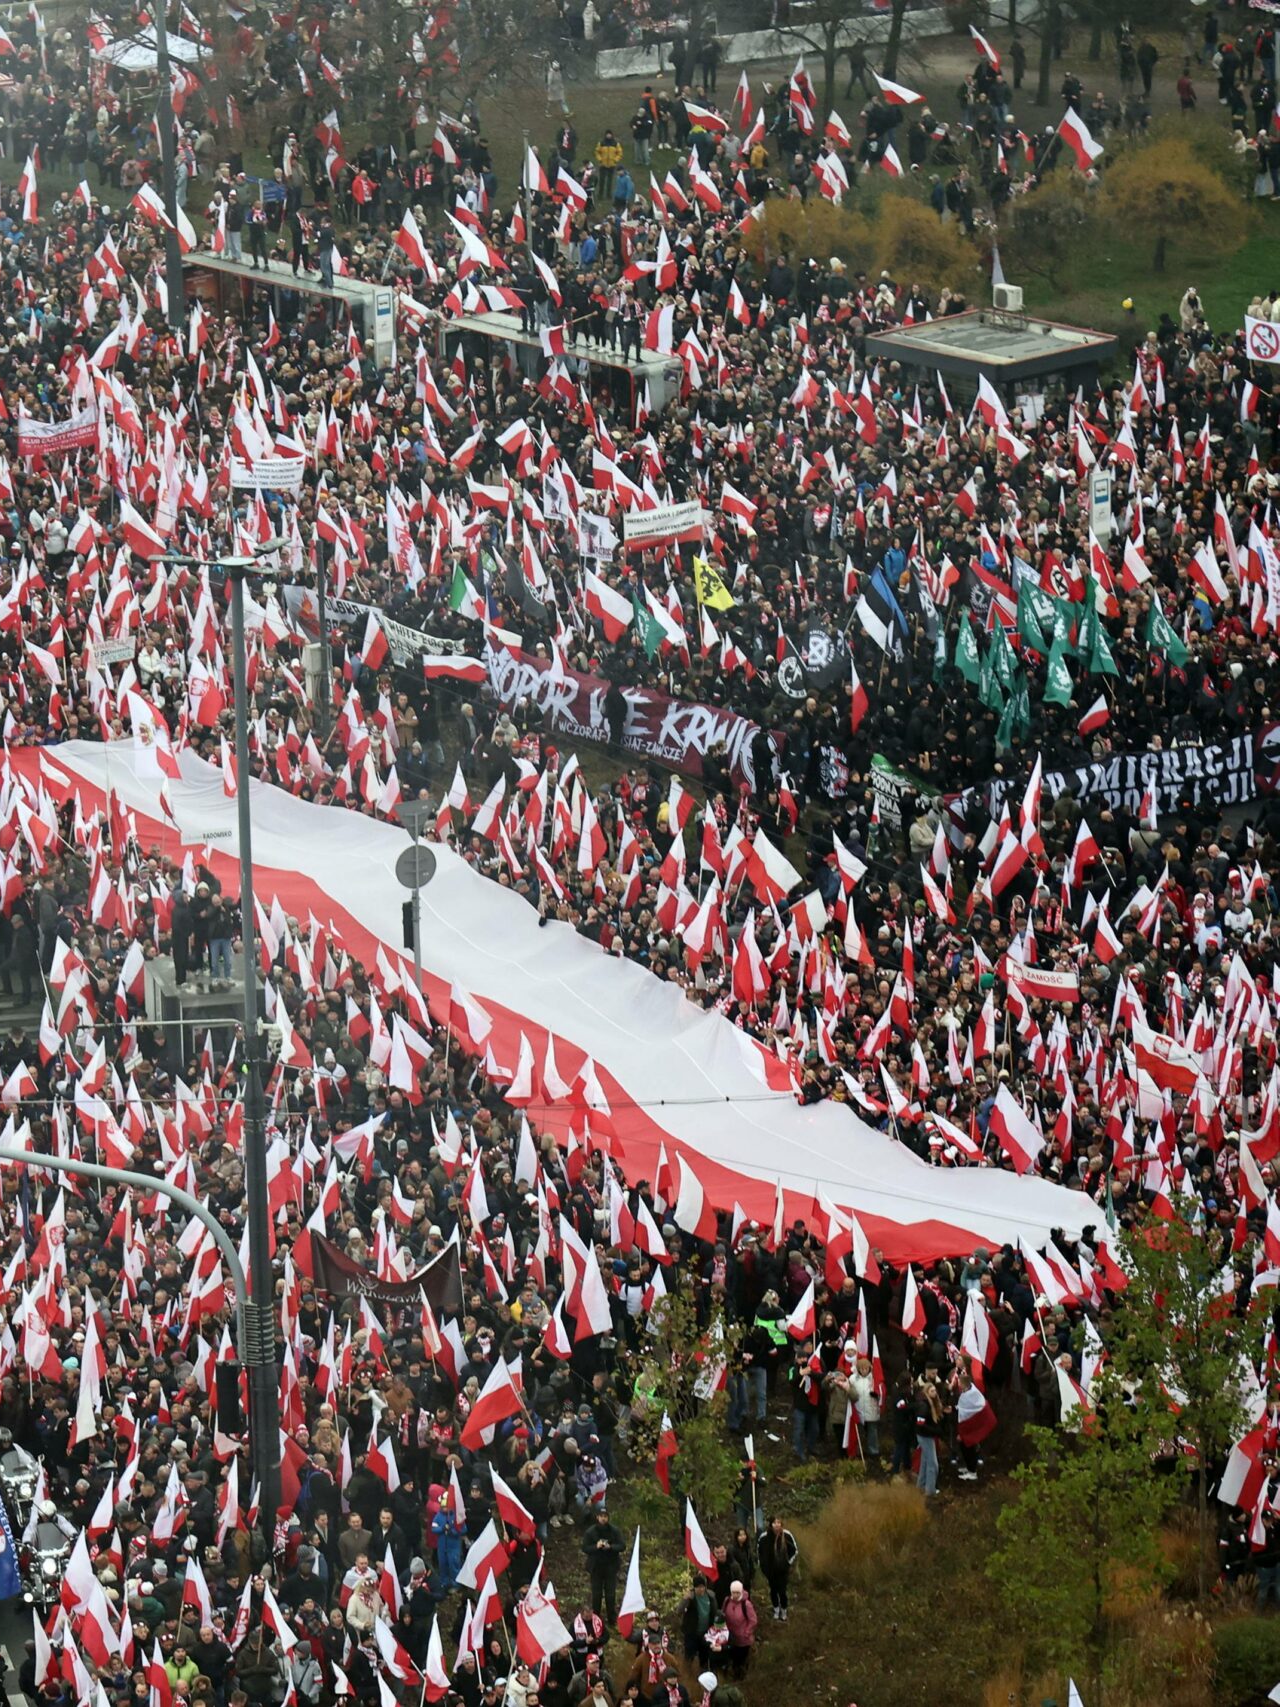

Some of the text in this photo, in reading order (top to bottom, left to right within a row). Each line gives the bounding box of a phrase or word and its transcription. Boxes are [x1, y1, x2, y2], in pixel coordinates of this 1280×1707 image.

[387, 619, 417, 641] WHITE
[422, 635, 463, 653] EUROE
[1075, 733, 1254, 800] IMIGRACJI
[1027, 971, 1063, 985] ZAMOŚĆ
